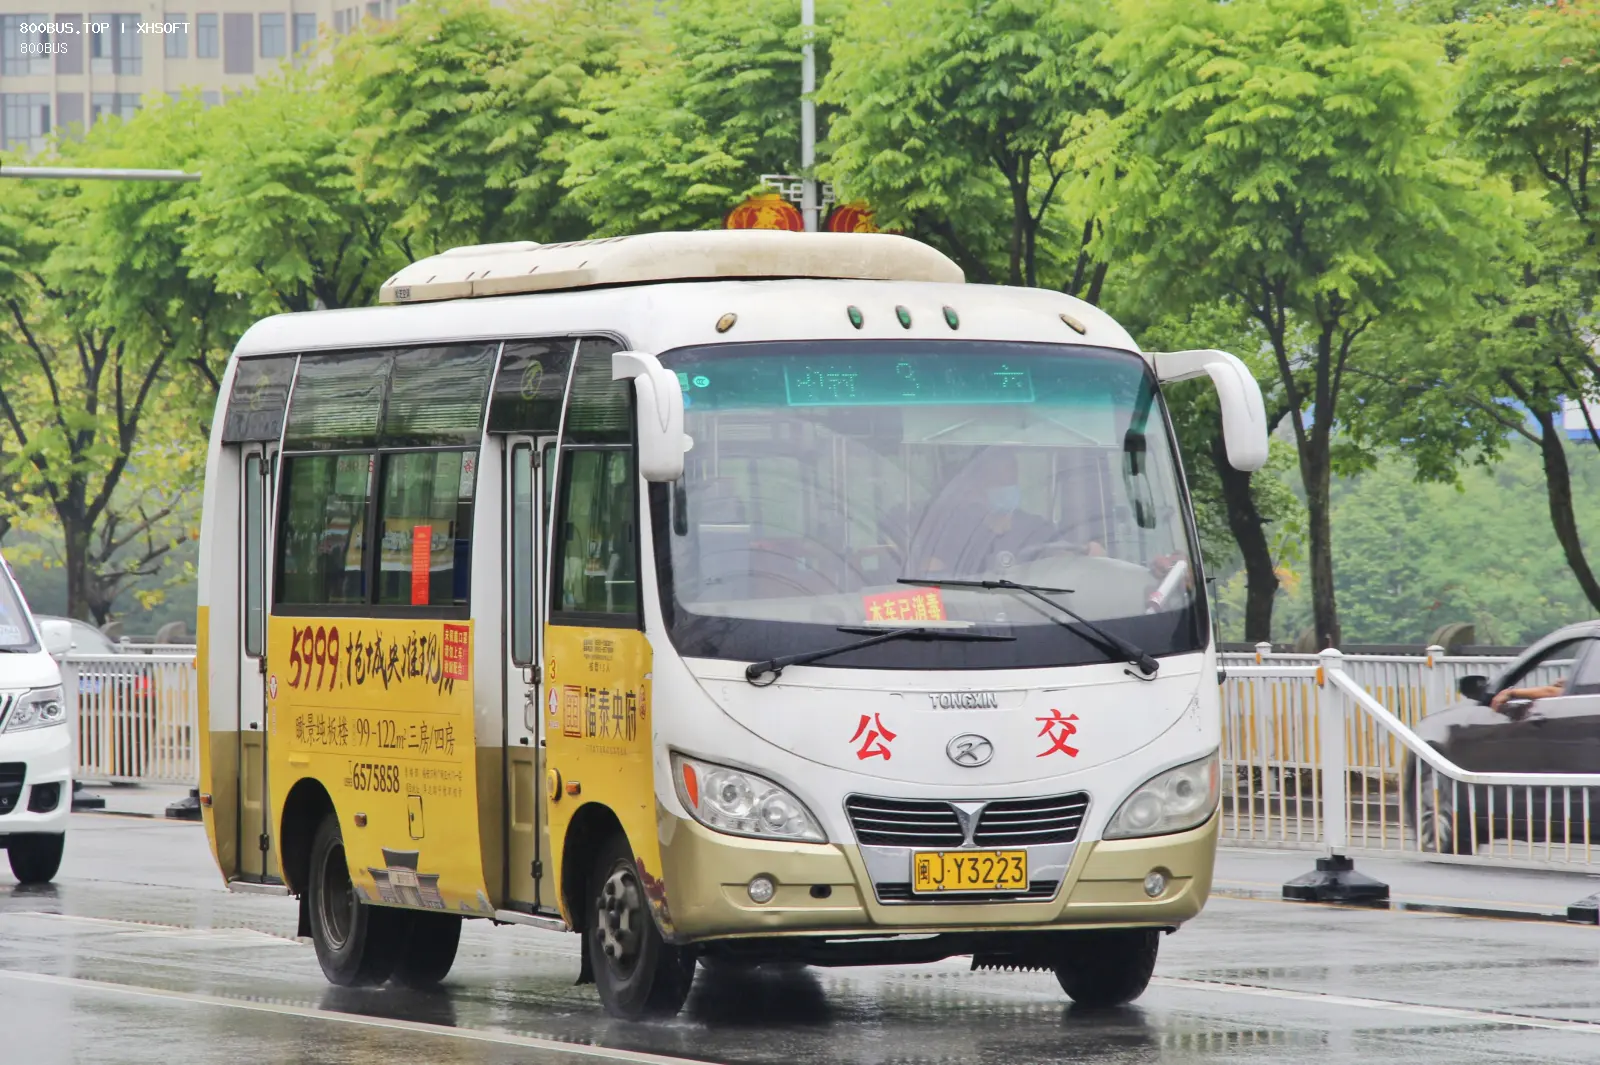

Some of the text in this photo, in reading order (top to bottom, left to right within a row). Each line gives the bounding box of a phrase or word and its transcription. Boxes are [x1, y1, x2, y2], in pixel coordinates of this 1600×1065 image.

[869, 592, 942, 622] 本车已消毒
[287, 626, 339, 691] 5999
[929, 692, 998, 710] TONGXIN
[848, 708, 1080, 761] 公 交
[353, 762, 400, 794] 6575858
